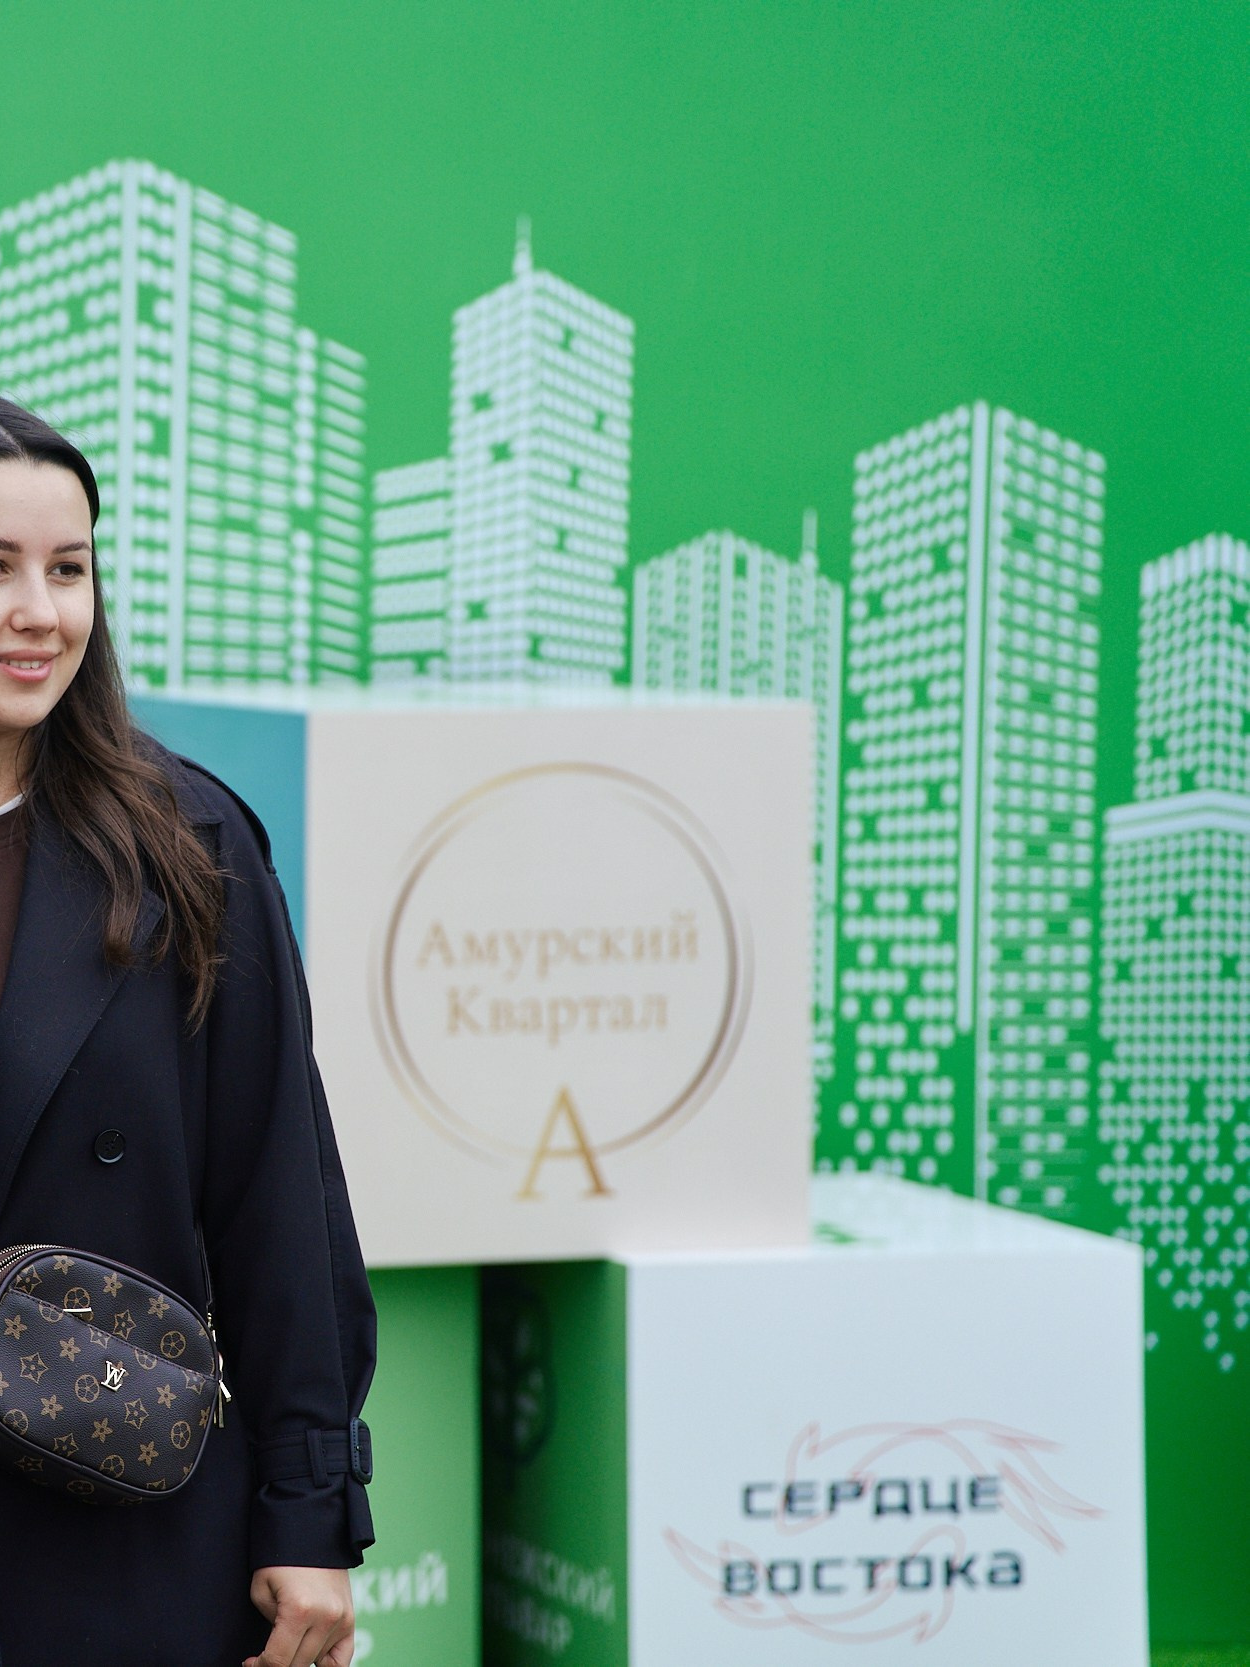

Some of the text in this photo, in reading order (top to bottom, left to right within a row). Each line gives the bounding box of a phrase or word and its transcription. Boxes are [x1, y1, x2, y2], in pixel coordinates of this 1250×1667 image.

[415, 911, 699, 981] Амурский
[447, 985, 668, 1046] Квартал
[740, 1474, 1004, 1521] СЕРДЦЕ
